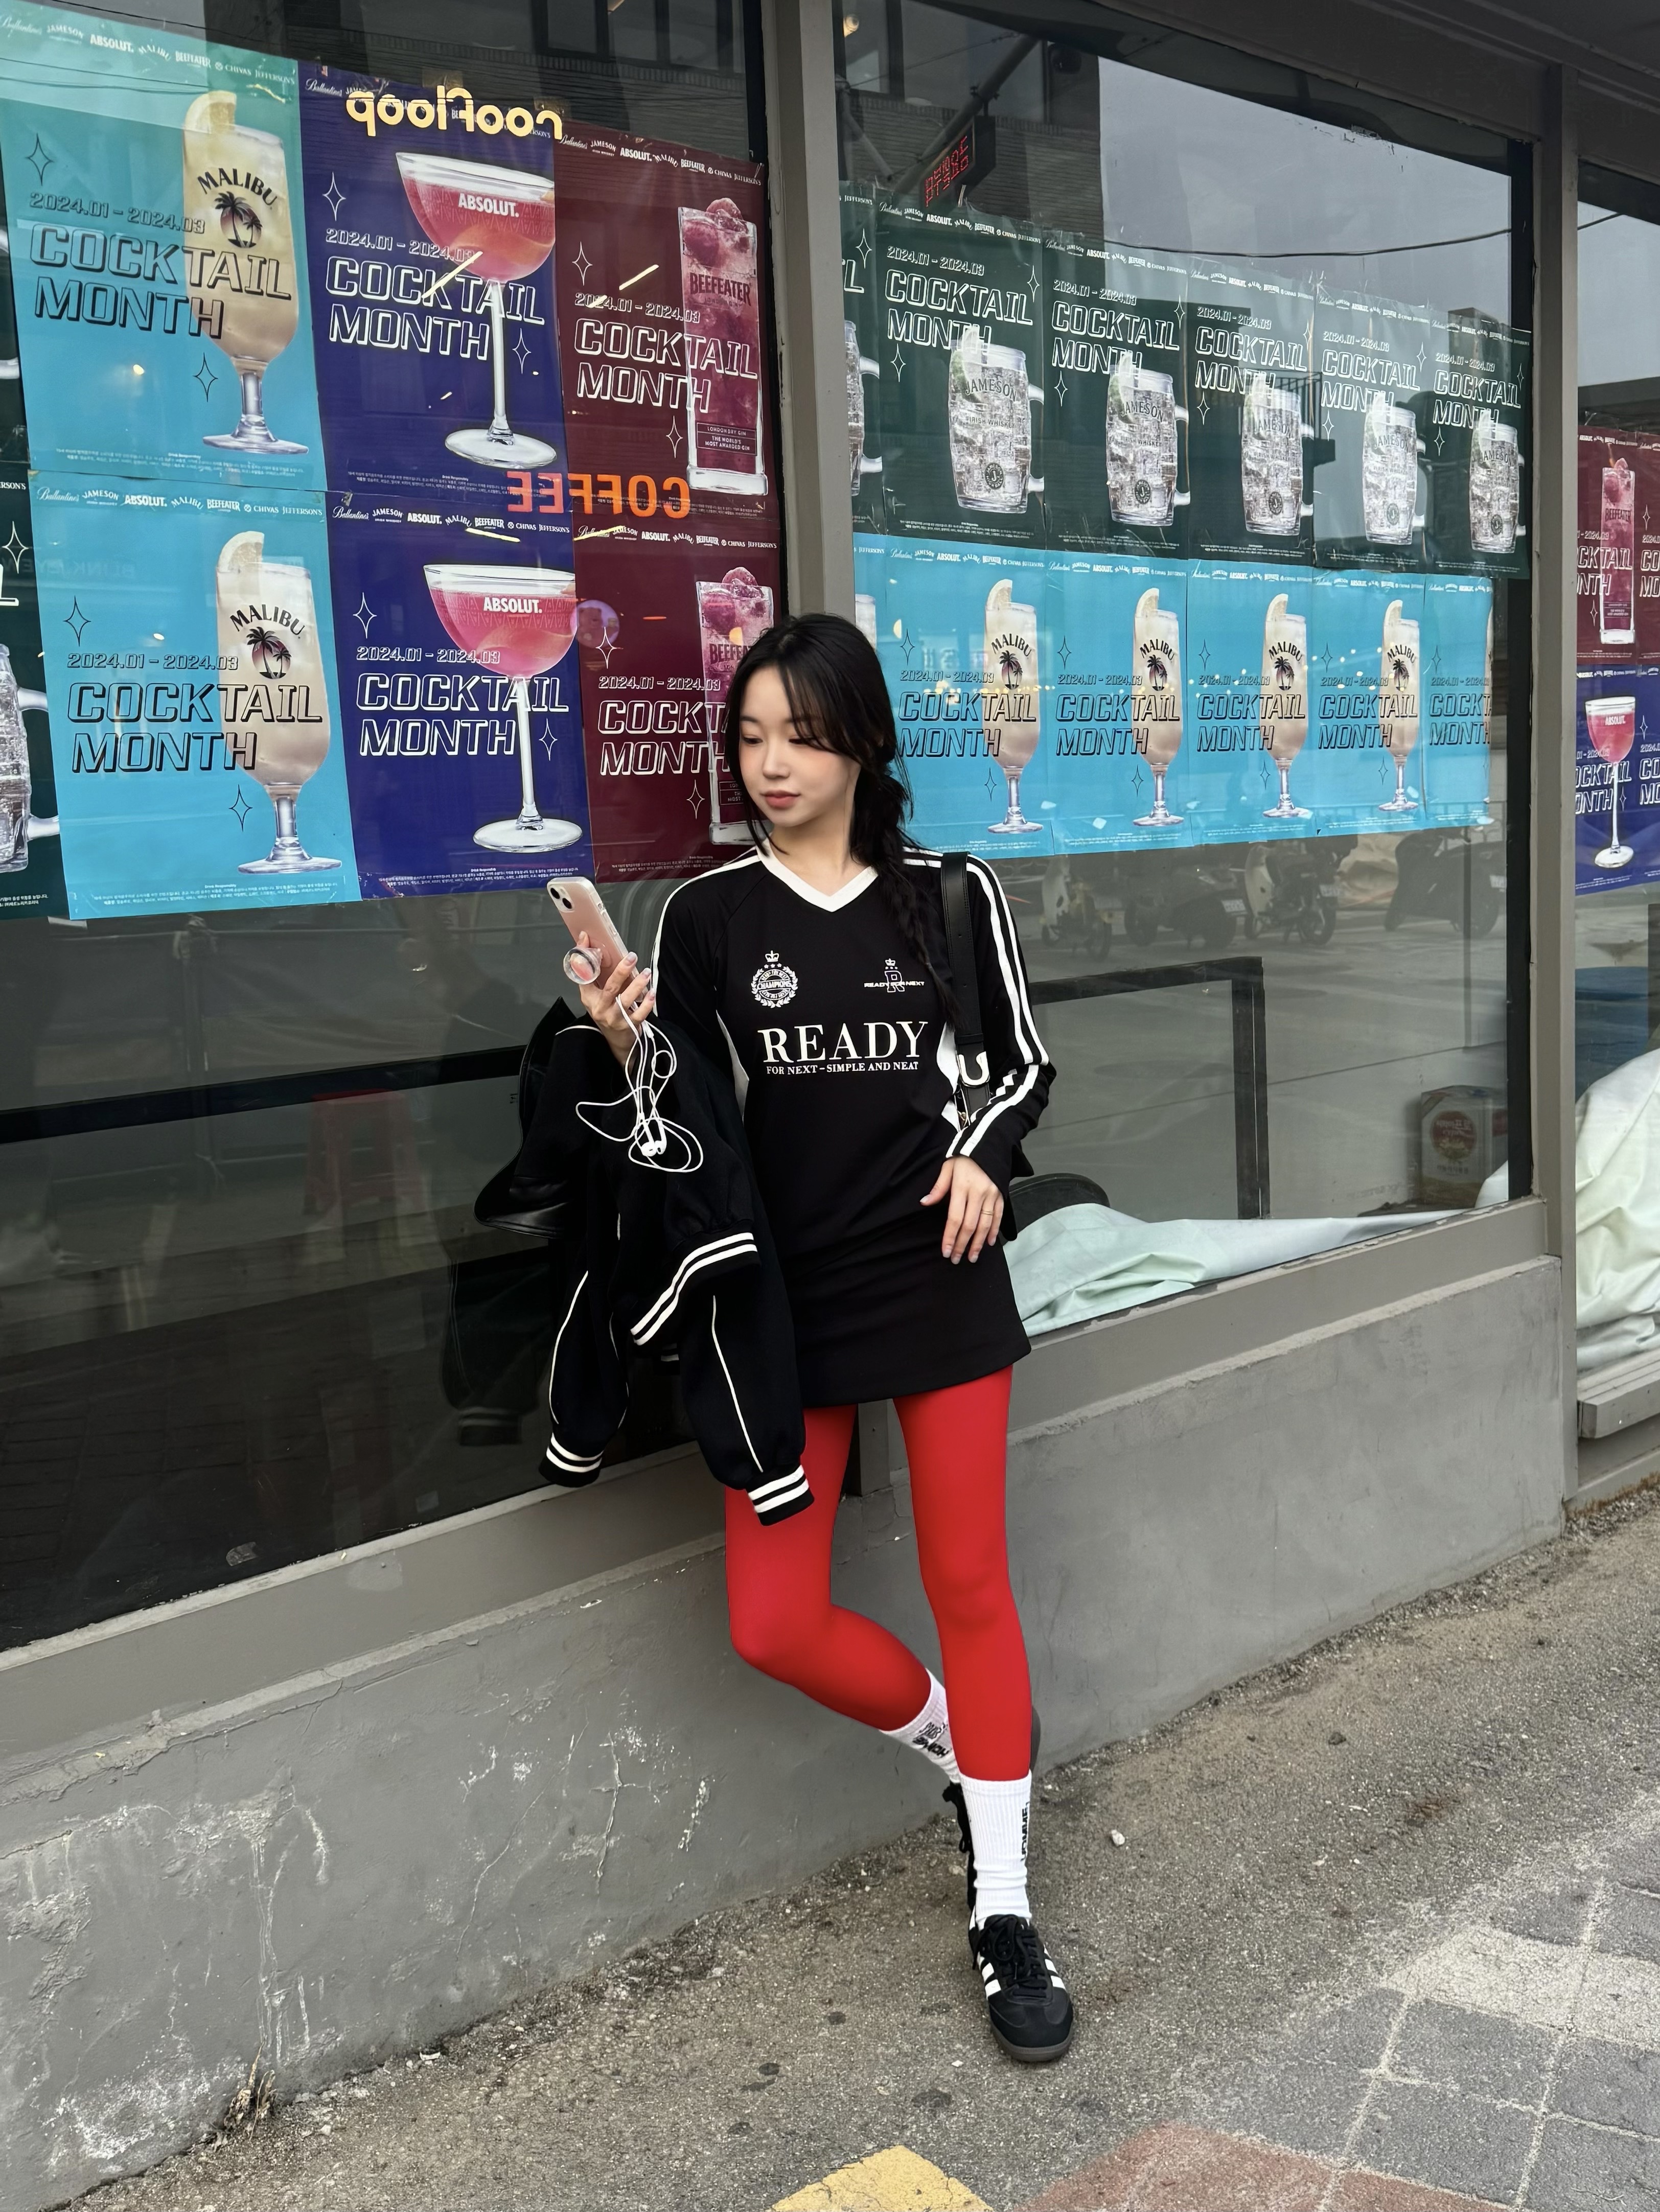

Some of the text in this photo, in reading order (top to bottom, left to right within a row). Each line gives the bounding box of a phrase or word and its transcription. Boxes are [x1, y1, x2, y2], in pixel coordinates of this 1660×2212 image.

[47, 25, 83, 37] JAMESON
[89, 34, 134, 53] ABSOLUT.
[138, 44, 171, 61] MALIBU
[175, 51, 211, 68] BEEFEATER
[225, 64, 251, 76] CHIVAS
[255, 69, 295, 84] JEFFERSON'S
[590, 140, 616, 152] JAMESON
[619, 147, 652, 161] ABSOLUT.
[680, 158, 706, 174] BEEFEATER
[197, 167, 278, 207] MALIBU
[30, 191, 205, 235] 2024.01 2024.03
[458, 193, 519, 218] ABSOLUT.
[927, 214, 953, 226] ABSOLUT.
[326, 228, 392, 251] 2024.01
[30, 223, 291, 300] COCKTAIL
[887, 246, 929, 265] 2024.01
[326, 255, 545, 325] COCKTAIL
[689, 273, 751, 306] BEEFEATER
[885, 269, 1033, 325] COCKTAIL
[34, 276, 224, 340] MONTH
[645, 302, 700, 324] 2024.03
[329, 304, 490, 361] MONTH
[887, 308, 992, 355] MONTH
[1052, 300, 1180, 351] COCKTAIL
[574, 317, 758, 379] COCKTAIL
[1052, 337, 1142, 380] MONTH
[1195, 326, 1307, 371] COCKTAIL
[1195, 360, 1276, 399] MONTH
[1322, 349, 1420, 391] COCKTAIL
[578, 362, 711, 413] MONTH
[965, 377, 1016, 402] JAMESON
[1321, 381, 1394, 413] MONTH
[1433, 370, 1521, 409] COCKTAIL
[1121, 403, 1164, 423] JAMESON
[1433, 399, 1500, 430] MONTH
[0, 481, 26, 491] RSON'S
[82, 490, 119, 500] JAMESON
[125, 494, 168, 507] ABSOLUT.
[171, 496, 204, 510] MALIBU
[207, 499, 240, 511] BEEFEATER
[283, 506, 322, 516] JEFFERSON'S
[333, 506, 369, 520] Ballantine's
[372, 508, 403, 519] JAMESON
[407, 513, 443, 524] ABSOLUT.
[445, 515, 472, 528] MALIBU
[474, 517, 504, 529] BEEFEATER
[516, 522, 537, 530] CHIVAS
[539, 524, 570, 533] JEFFERSON'S
[641, 531, 670, 542] ABSOLUT.
[673, 533, 694, 544] MALIBU
[696, 535, 719, 546] BEEFEATER
[1577, 545, 1633, 570] CKTAIL
[483, 596, 542, 614] ABSOLUT.
[230, 604, 306, 639] MALIBU
[356, 646, 500, 664] 2024.01 2024.03
[991, 633, 1032, 657] MALIBU
[1140, 638, 1175, 661] MALIBU
[1269, 641, 1302, 661] MALIBU
[1387, 644, 1416, 664] MALIBU
[67, 653, 239, 670] 2024.01 2024.03
[900, 670, 943, 682] 2024.01
[356, 673, 569, 712] COCKTAIL
[598, 676, 721, 691] 2024.01 2024.03
[1058, 674, 1097, 685] 2024.01
[67, 682, 323, 723] COCKTAIL
[597, 700, 727, 734] COCKT
[898, 691, 1036, 722] COCKTAIL
[1055, 694, 1180, 722] COCKTAIL
[1196, 694, 1305, 720] COCKTAIL
[1318, 694, 1418, 718] COCKTAIL
[360, 718, 516, 756] MONTH
[899, 728, 1001, 758] MONTH
[1056, 728, 1149, 756] MONTH
[1197, 725, 1275, 752] MONTH
[1318, 724, 1393, 749] MONTH
[72, 732, 257, 773] MONTH
[600, 741, 730, 776] MONTH
[757, 979, 793, 990] CHAMPIONS
[757, 1021, 928, 1063] READY
[767, 1061, 918, 1075] FOR NEXT SIMPLE AND NEAT
